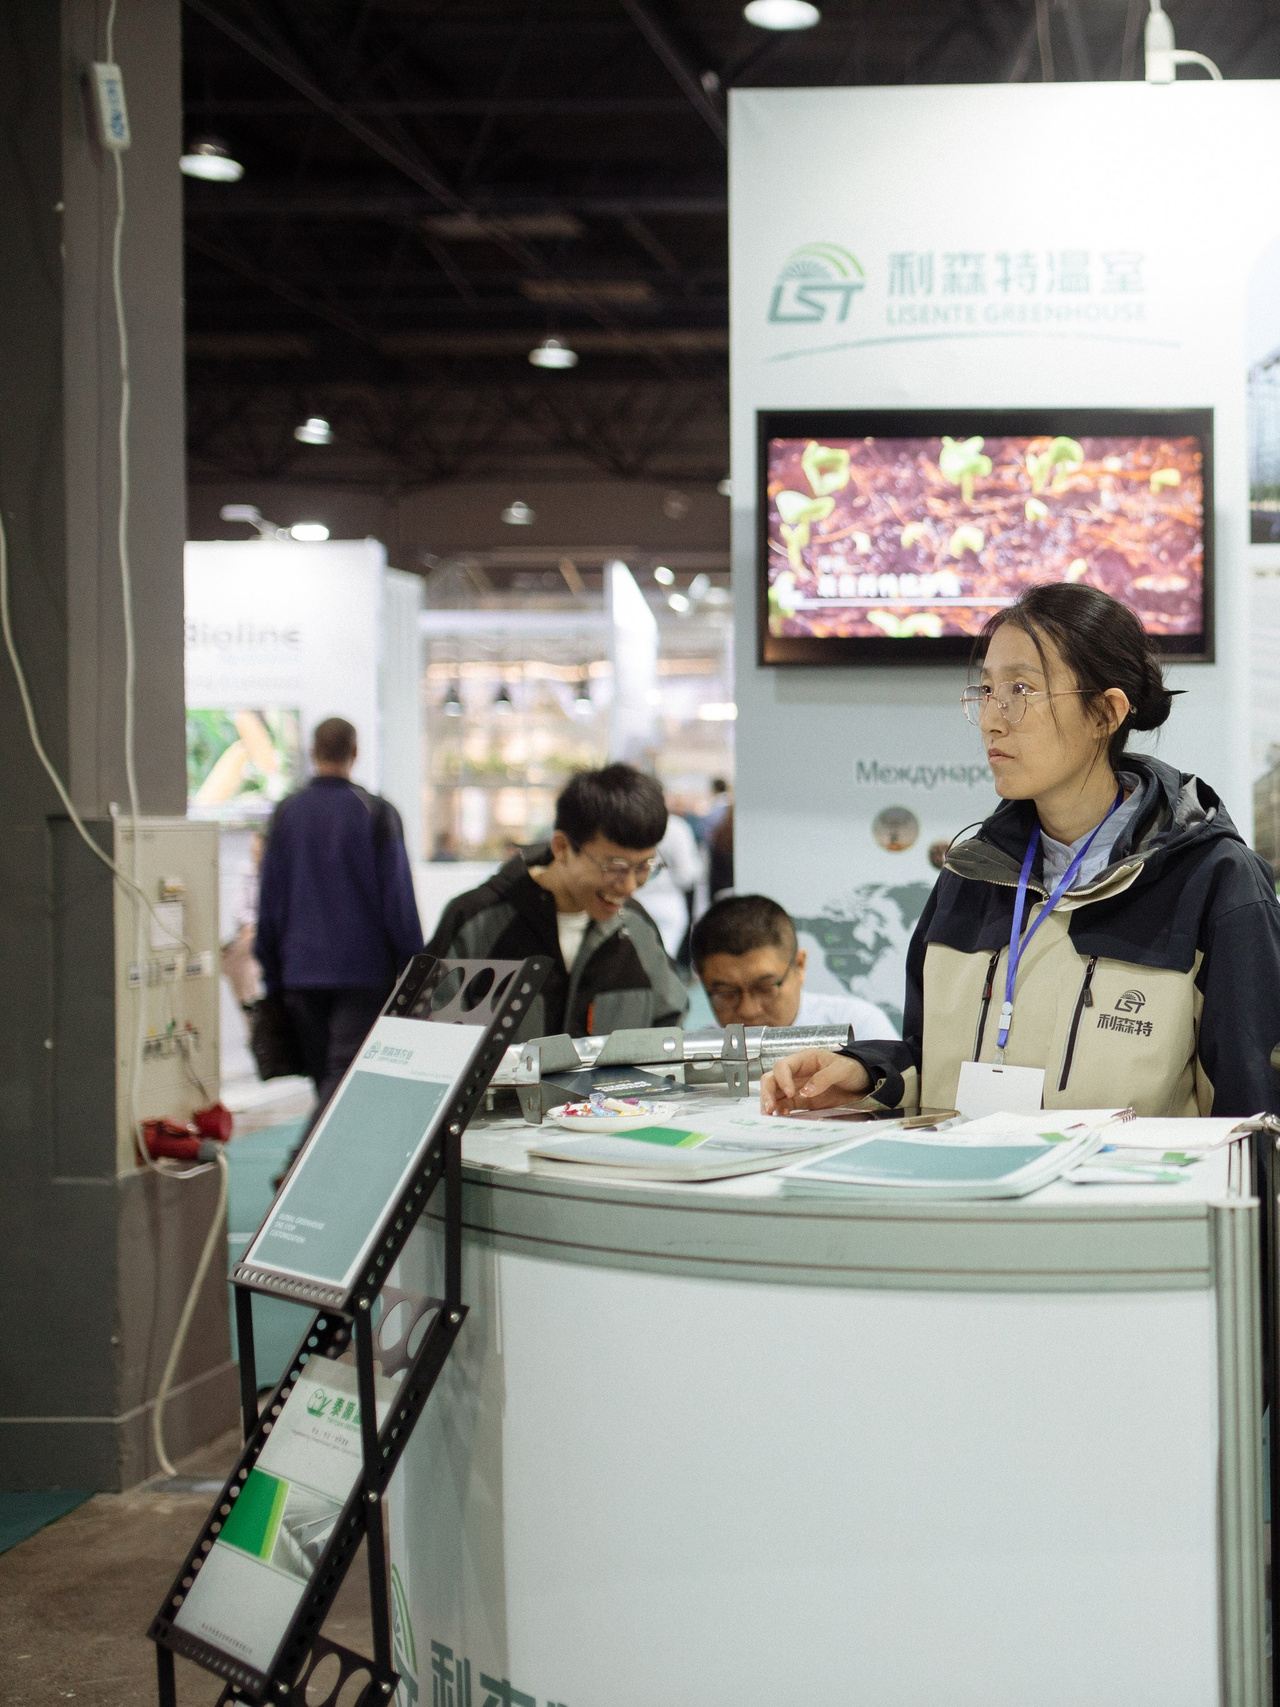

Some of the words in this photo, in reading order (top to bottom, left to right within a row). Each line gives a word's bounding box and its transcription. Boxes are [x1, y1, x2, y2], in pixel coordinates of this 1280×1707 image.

[887, 251, 1146, 297] 利森特温室
[887, 303, 977, 325] LISENTE
[983, 302, 1146, 323] GREENHOUSE
[1097, 1013, 1154, 1037] 利森特
